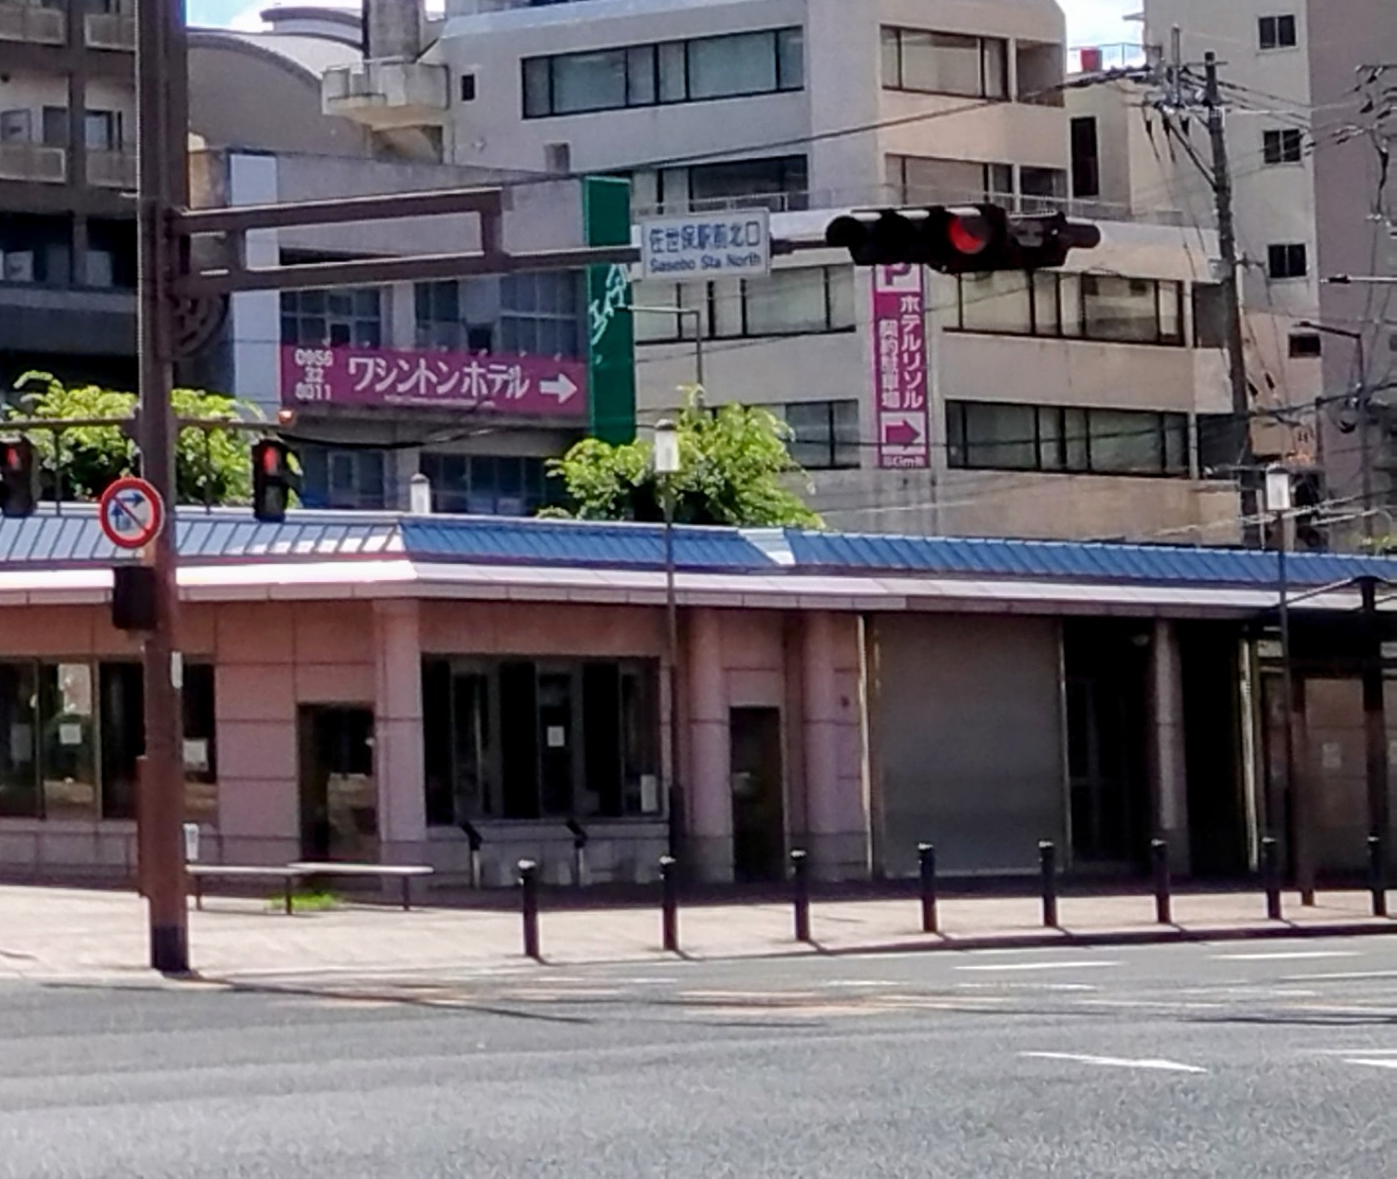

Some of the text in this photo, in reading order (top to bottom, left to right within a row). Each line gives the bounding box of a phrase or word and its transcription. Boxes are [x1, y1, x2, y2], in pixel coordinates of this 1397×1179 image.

[649, 220, 760, 254] 佐世保駅前北口
[649, 252, 761, 273] Sasebo Sta North
[900, 294, 924, 409] ホテルリソル
[348, 356, 531, 400] ワシントンホテル
